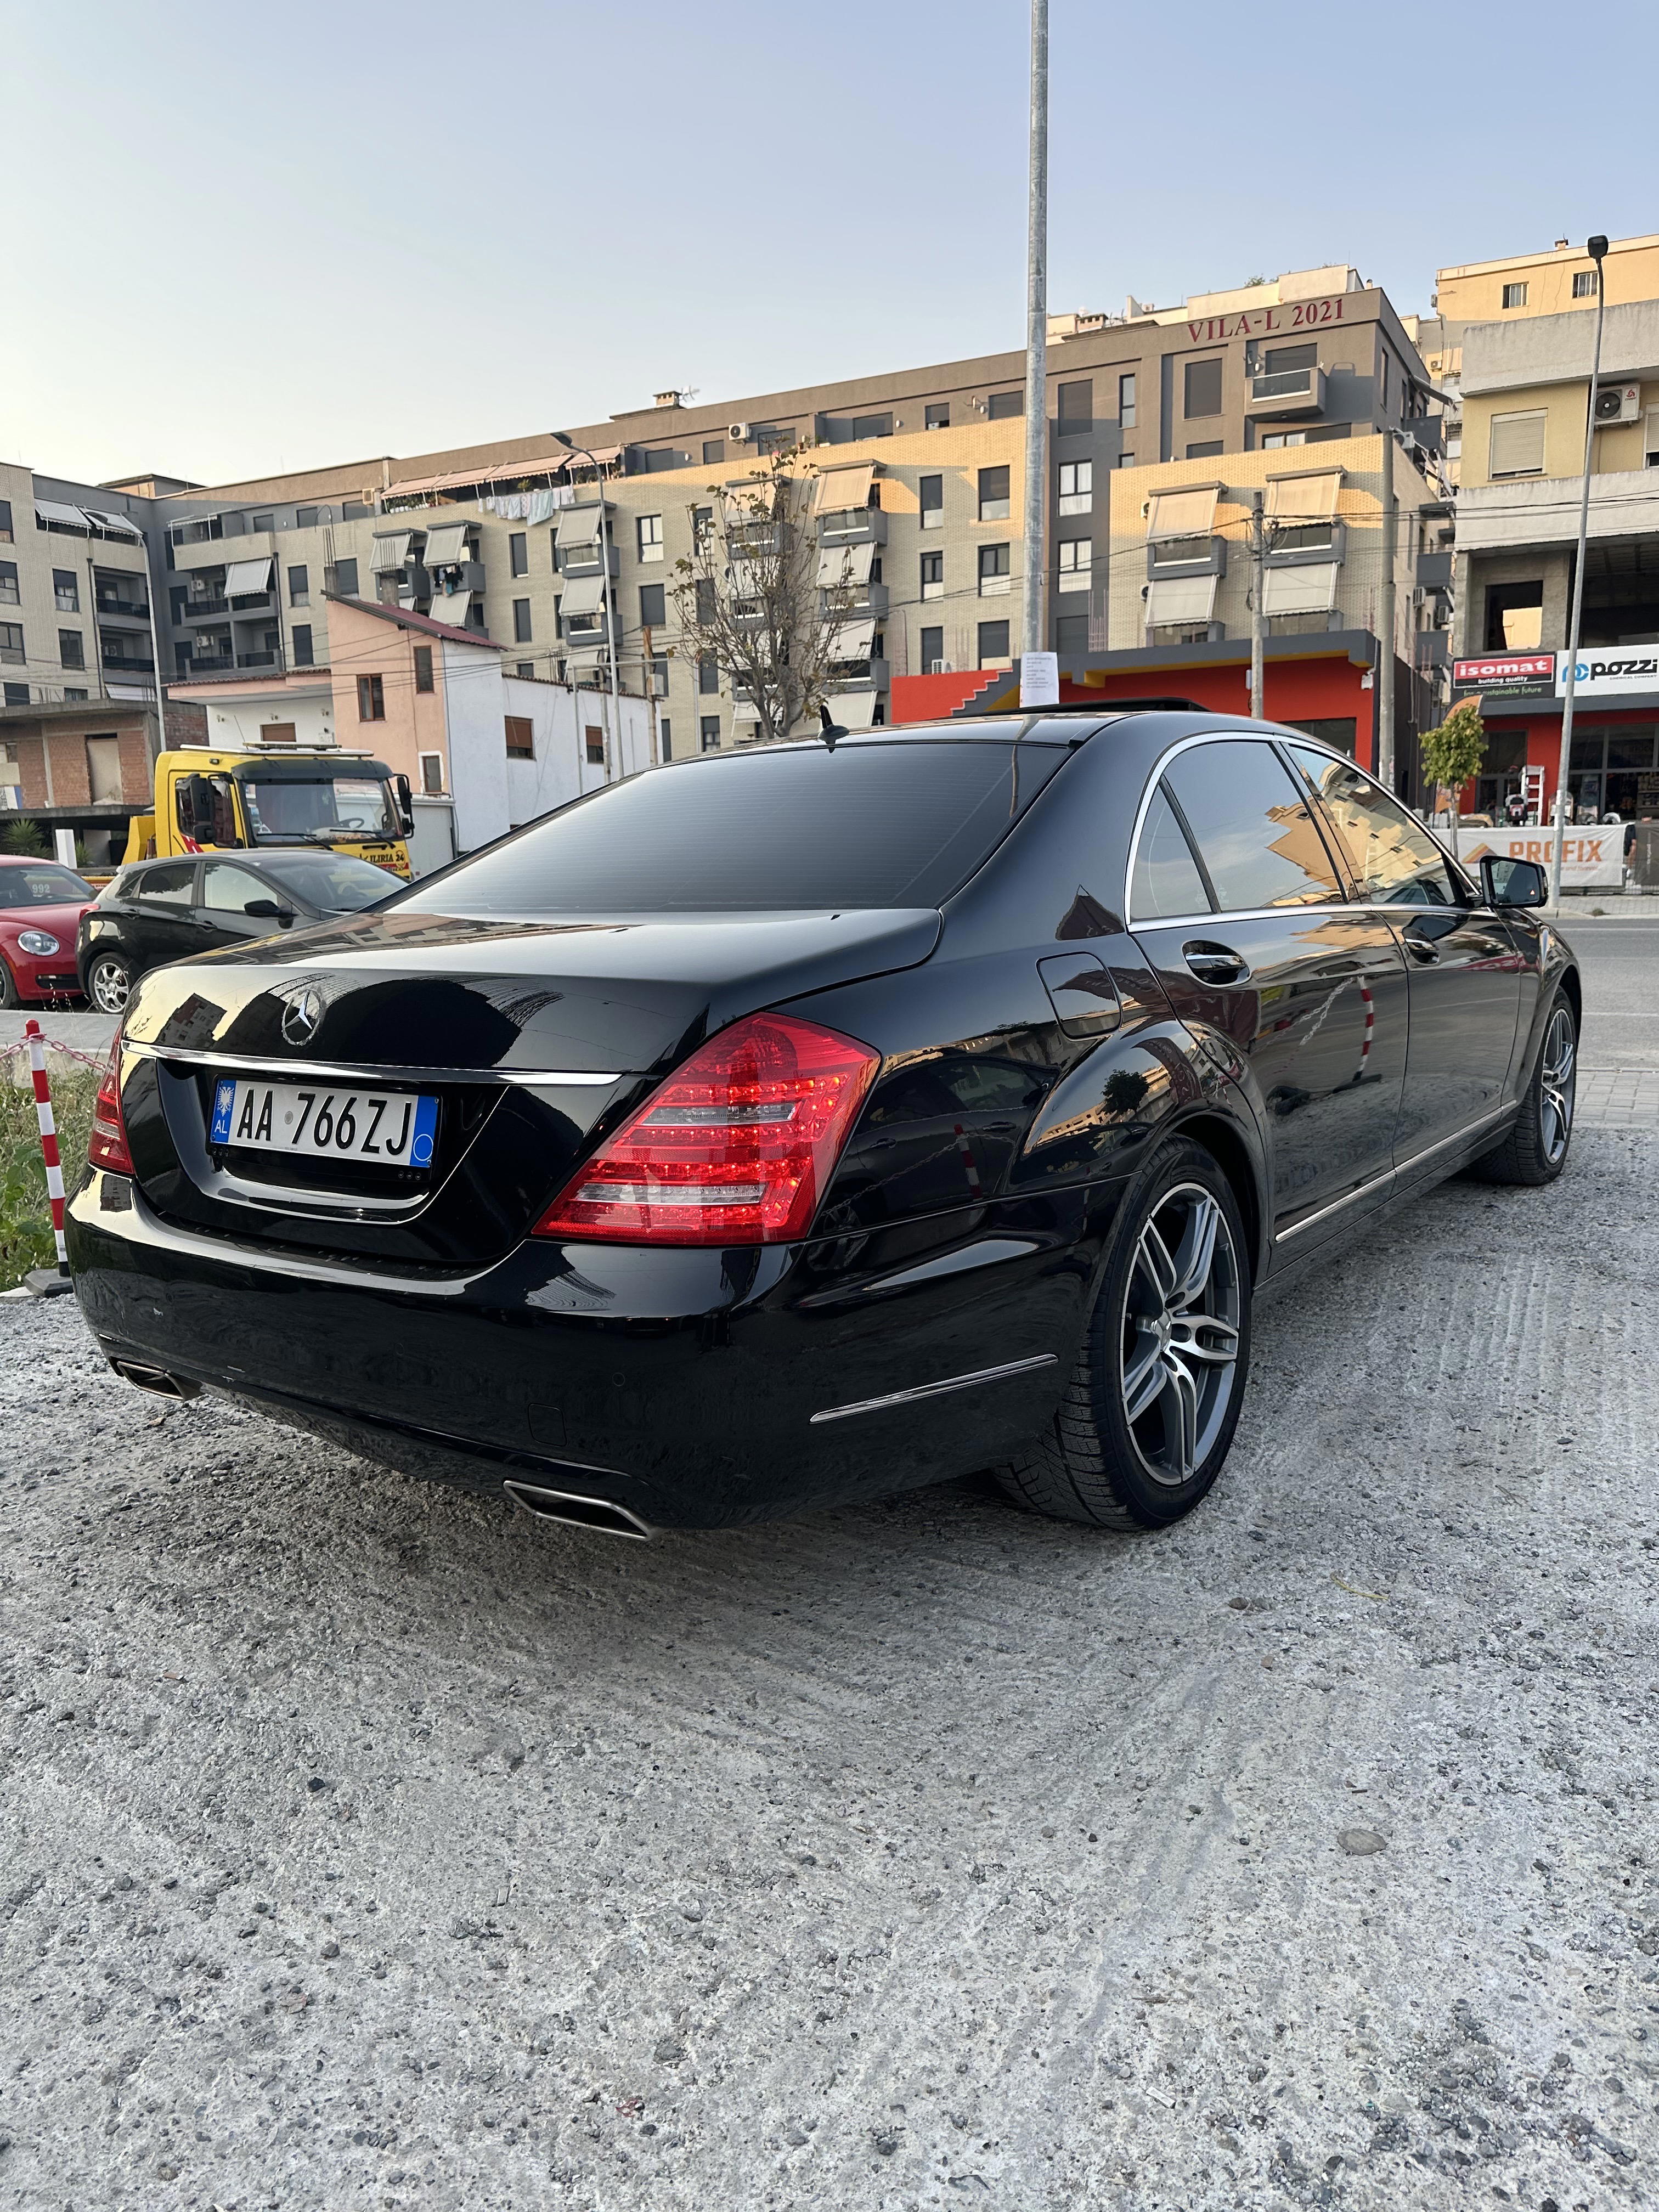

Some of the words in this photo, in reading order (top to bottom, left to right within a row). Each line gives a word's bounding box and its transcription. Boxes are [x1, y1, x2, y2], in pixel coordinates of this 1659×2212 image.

[1188, 310, 1281, 342] VILA-L
[1292, 298, 1344, 326] 2021
[1459, 660, 1548, 676] isomat
[1590, 659, 1658, 681] pozzi
[1521, 686, 1542, 695] future
[370, 854, 394, 863] ILIRIA
[215, 1119, 228, 1135] AL
[236, 1087, 274, 1141] AA
[291, 1091, 412, 1155] 766ZJ
